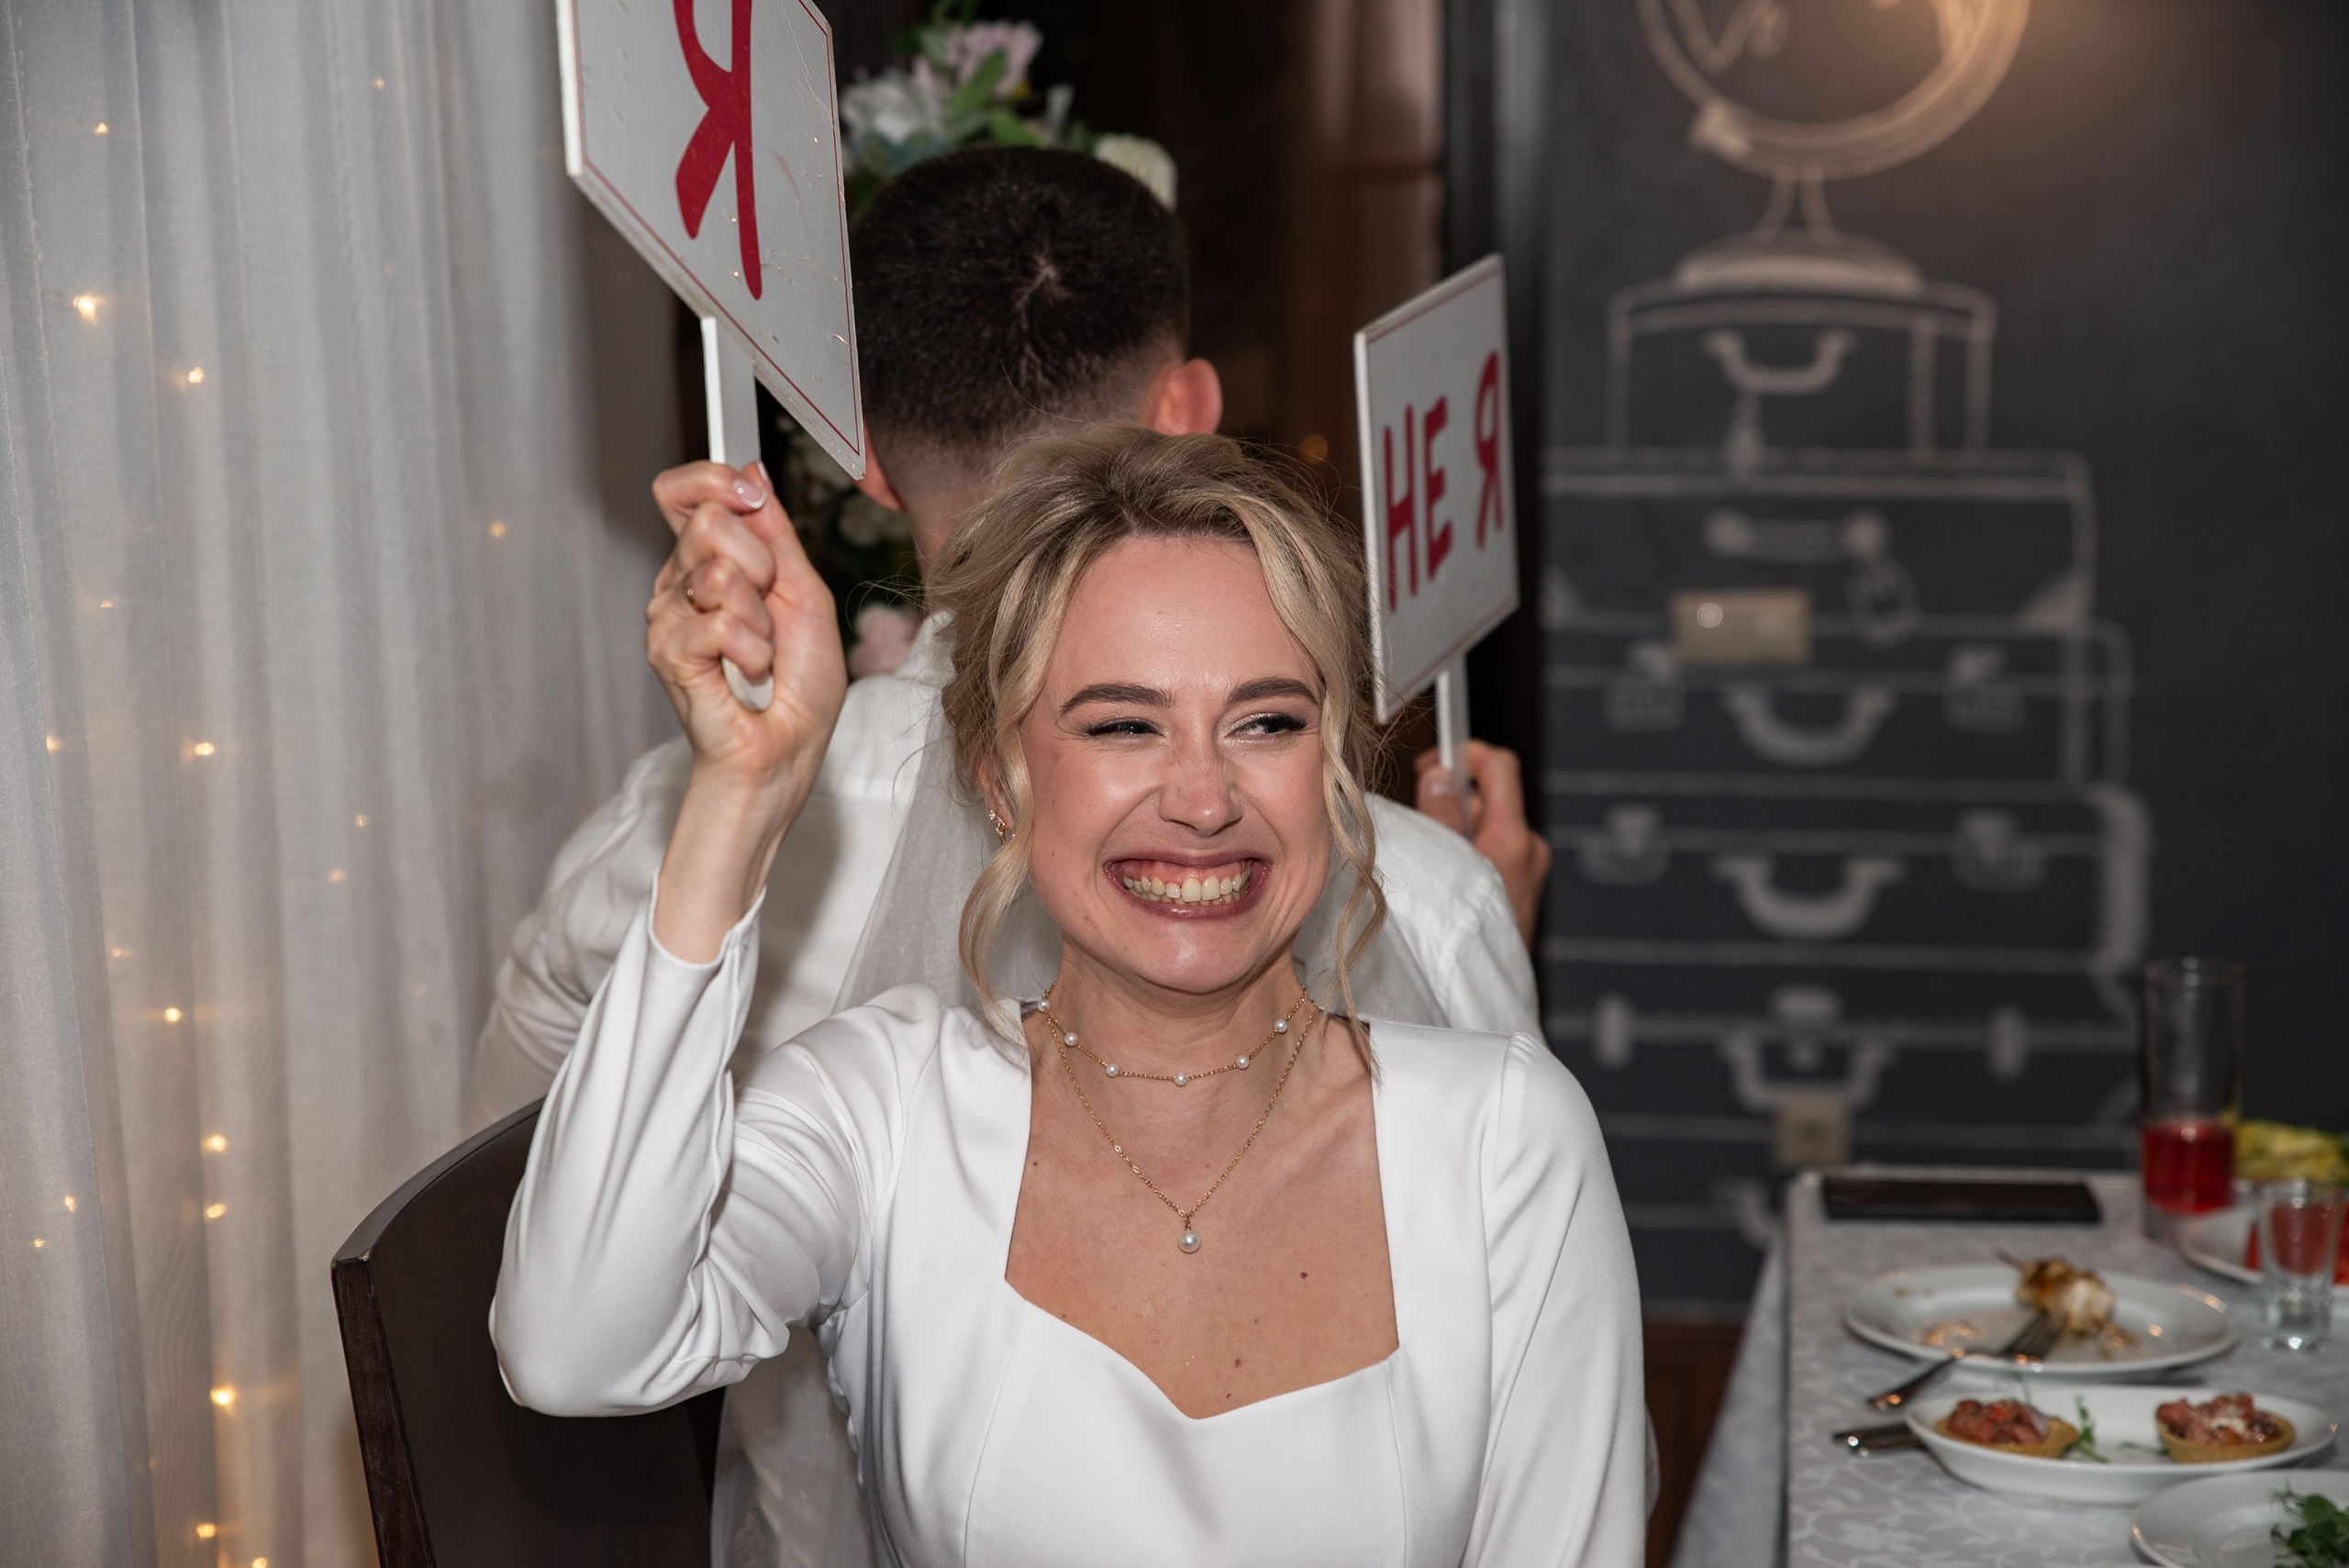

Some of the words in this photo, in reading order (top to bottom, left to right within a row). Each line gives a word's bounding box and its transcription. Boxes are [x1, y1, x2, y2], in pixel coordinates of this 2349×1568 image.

[673, 0, 763, 301] Я
[1384, 395, 1453, 613] НЕ
[1475, 350, 1503, 550] Я
